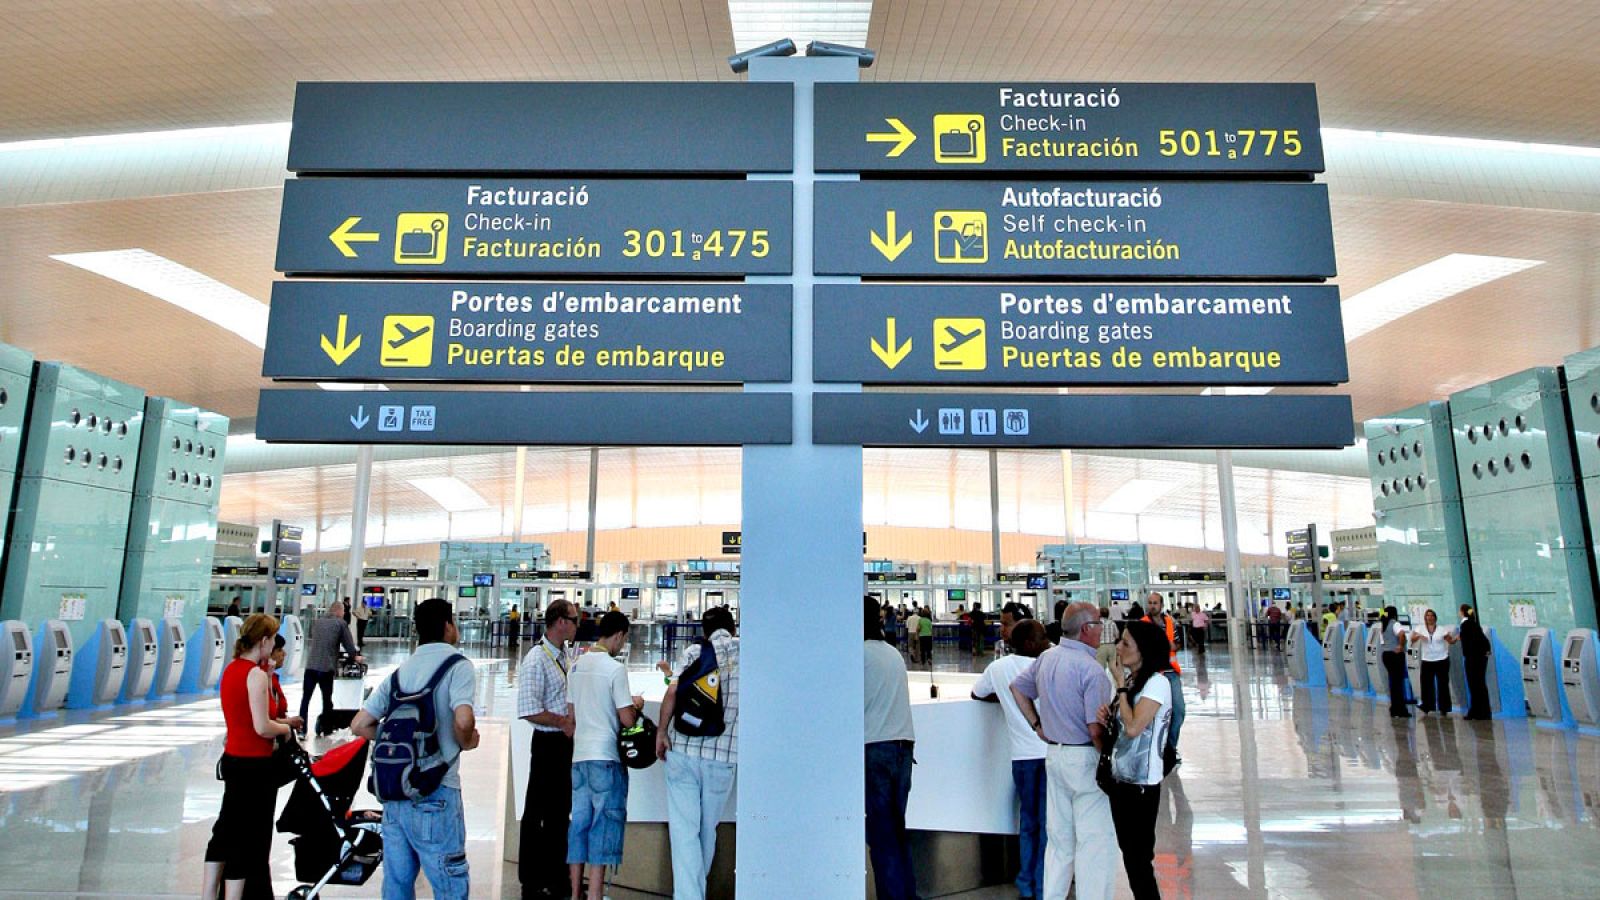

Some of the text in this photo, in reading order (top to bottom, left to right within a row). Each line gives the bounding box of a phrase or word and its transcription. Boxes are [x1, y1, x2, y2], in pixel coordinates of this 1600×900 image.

[1000, 88, 1120, 107] Facturació
[1001, 115, 1085, 131] Check-in
[1002, 137, 1138, 156] Facturación
[1160, 130, 1301, 156] 501 to 775
[1228, 149, 1236, 159] a
[468, 185, 588, 206] Facturació
[1001, 187, 1162, 207] Autofacturació
[465, 213, 551, 231] Check-in
[1004, 214, 1146, 232] Self check-in
[464, 237, 600, 258] Facturación
[622, 230, 769, 258] 301 to 475
[1004, 238, 1179, 259] Autofacturación
[692, 250, 701, 260] a
[452, 290, 742, 313] Portes d'embarcament
[1000, 293, 1292, 314] Portes d'embarcament
[449, 318, 599, 341] Boarding gates
[1001, 321, 1152, 343] Boarding gates
[448, 344, 724, 371] Puertas de embarque
[1002, 346, 1280, 372] Puertas de embarque
[412, 418, 433, 426] FREE
